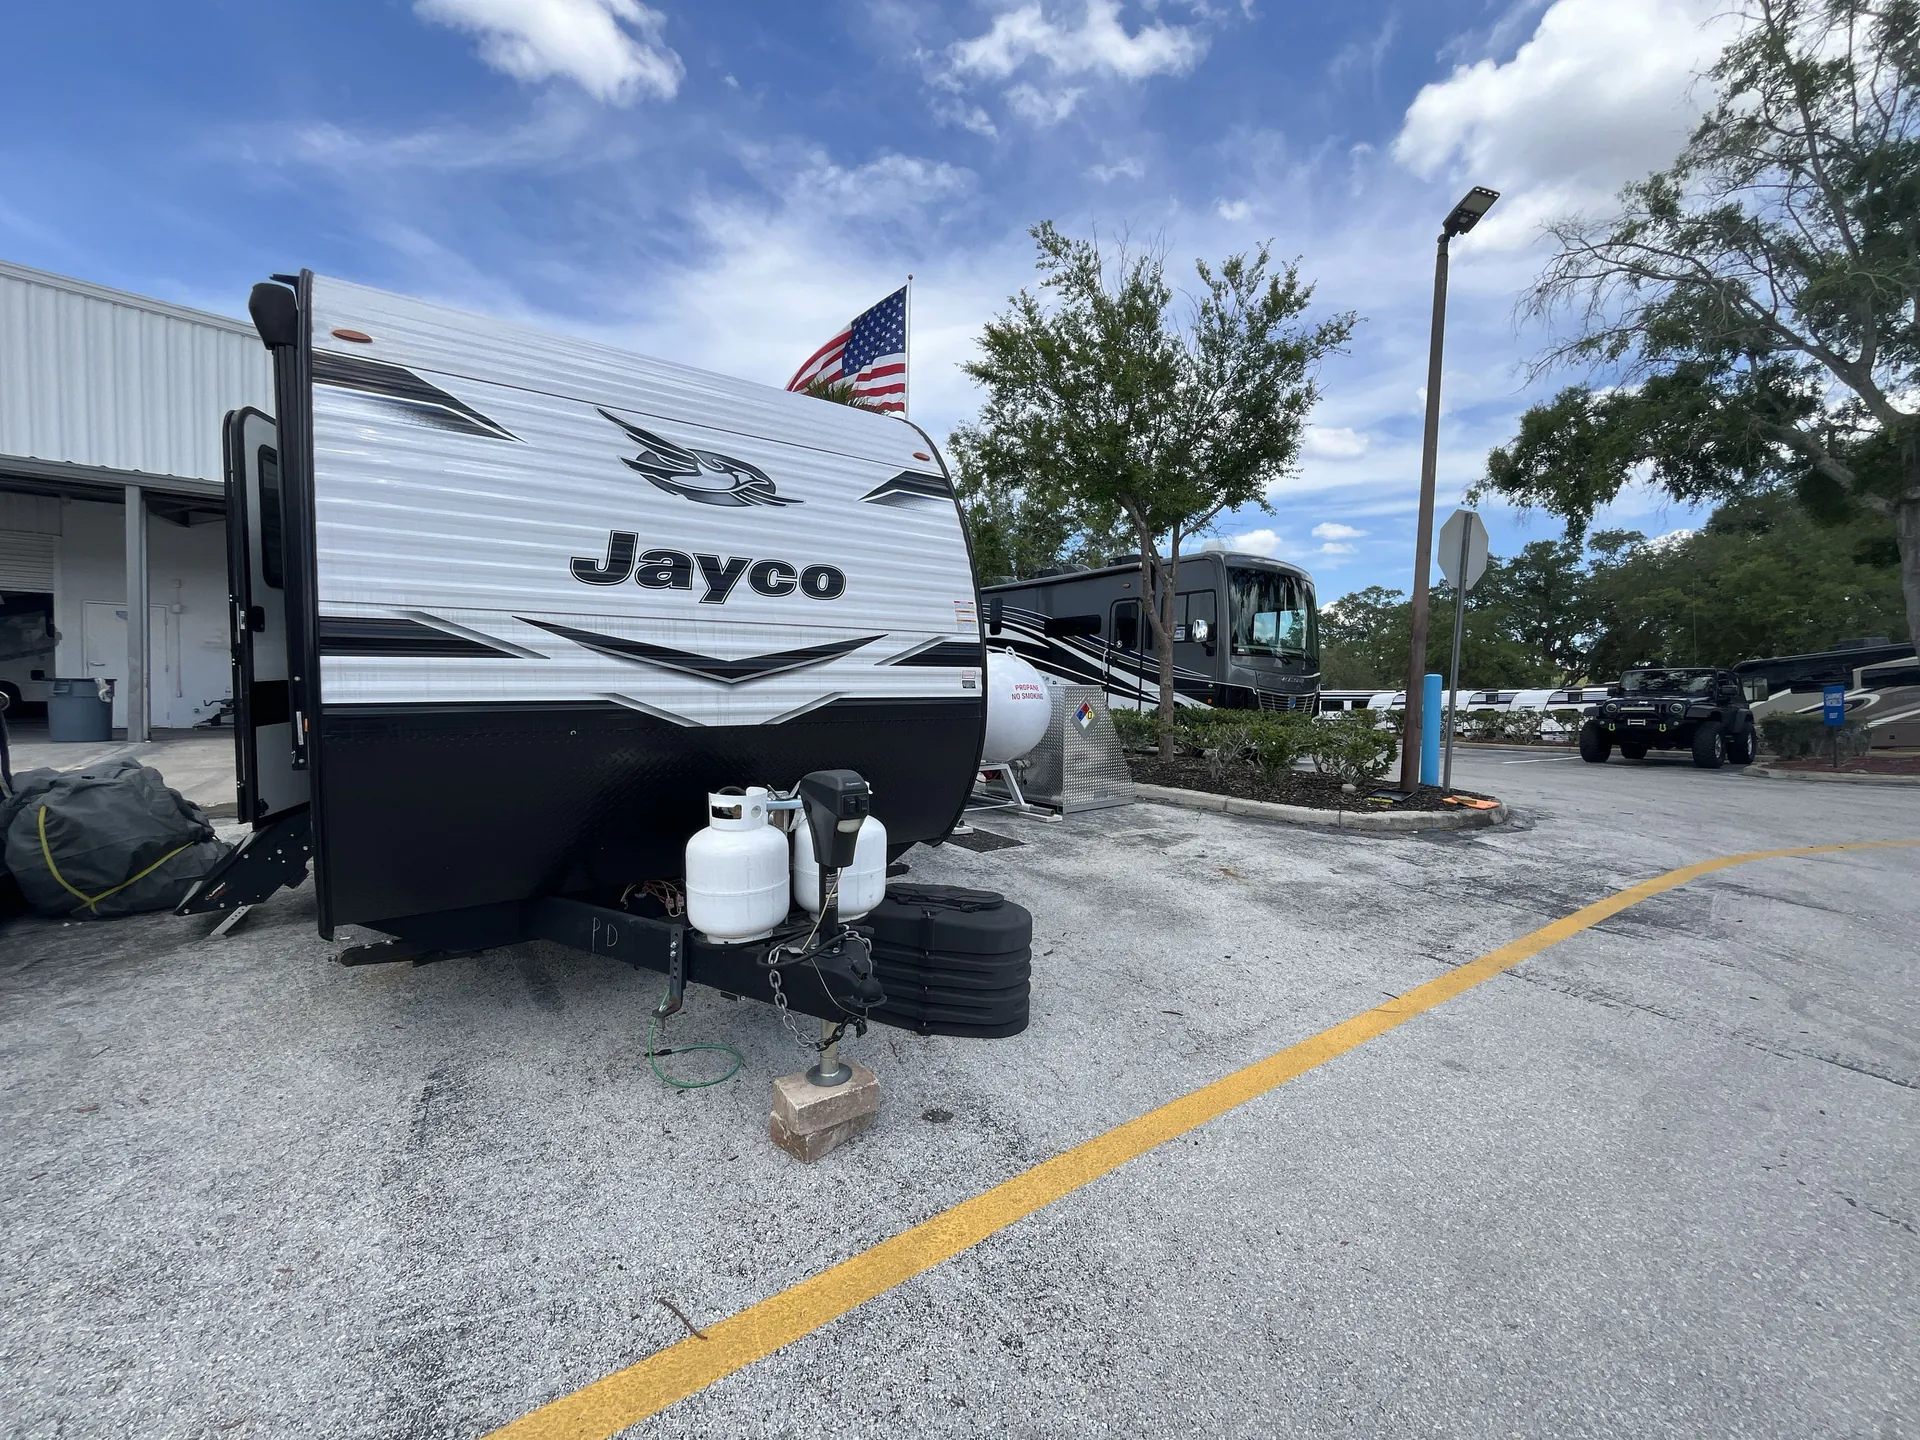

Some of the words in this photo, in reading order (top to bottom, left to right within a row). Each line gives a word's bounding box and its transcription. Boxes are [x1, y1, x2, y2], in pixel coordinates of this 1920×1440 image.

[569, 529, 847, 605] Jayco
[1014, 684, 1040, 692] PROPANE
[1021, 692, 1044, 700] SMOKING
